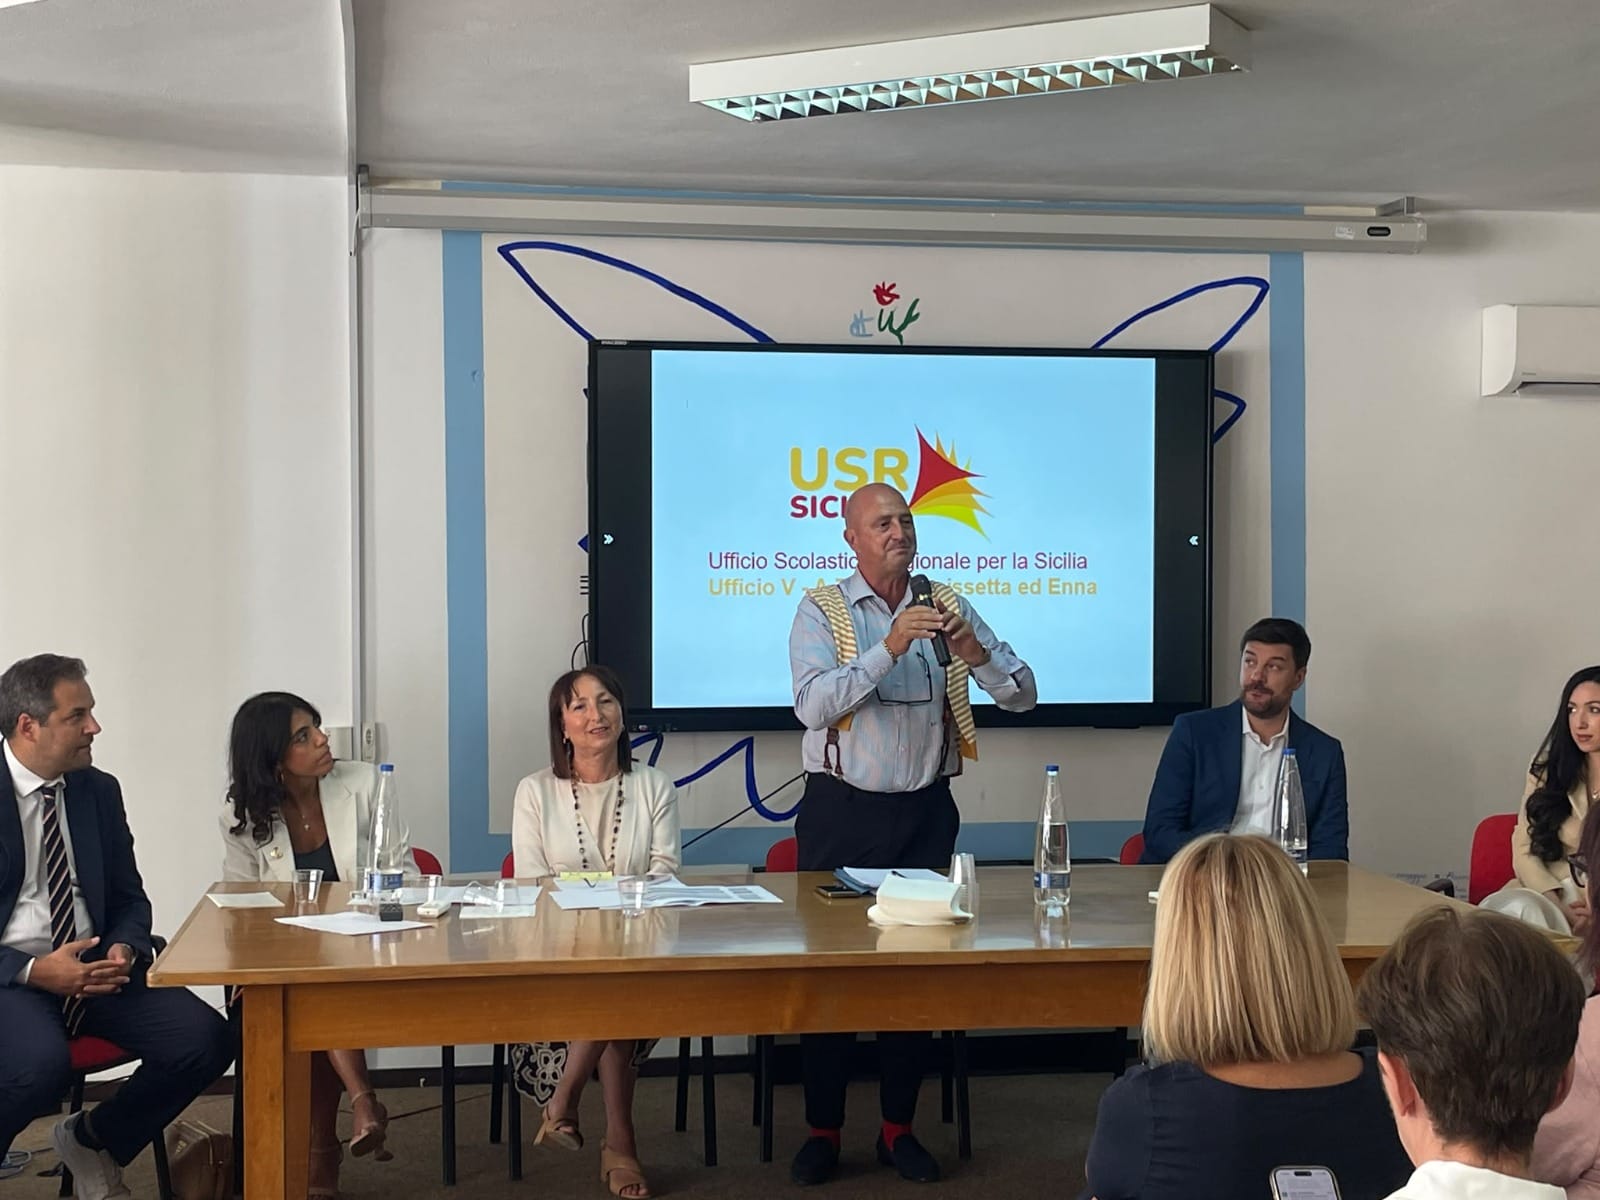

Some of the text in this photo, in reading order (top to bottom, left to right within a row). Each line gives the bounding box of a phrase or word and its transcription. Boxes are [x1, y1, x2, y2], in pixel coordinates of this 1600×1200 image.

[790, 447, 909, 491] USR
[790, 495, 847, 518] SICI
[709, 551, 768, 570] Ufficio
[774, 551, 859, 570] Scolastic
[977, 555, 1007, 573] per
[1013, 551, 1028, 570] la
[1034, 551, 1088, 570] Sicilia
[709, 578, 775, 596] Ufficio
[781, 578, 797, 596] V
[1018, 577, 1042, 596] ed
[1048, 577, 1097, 596] Enna
